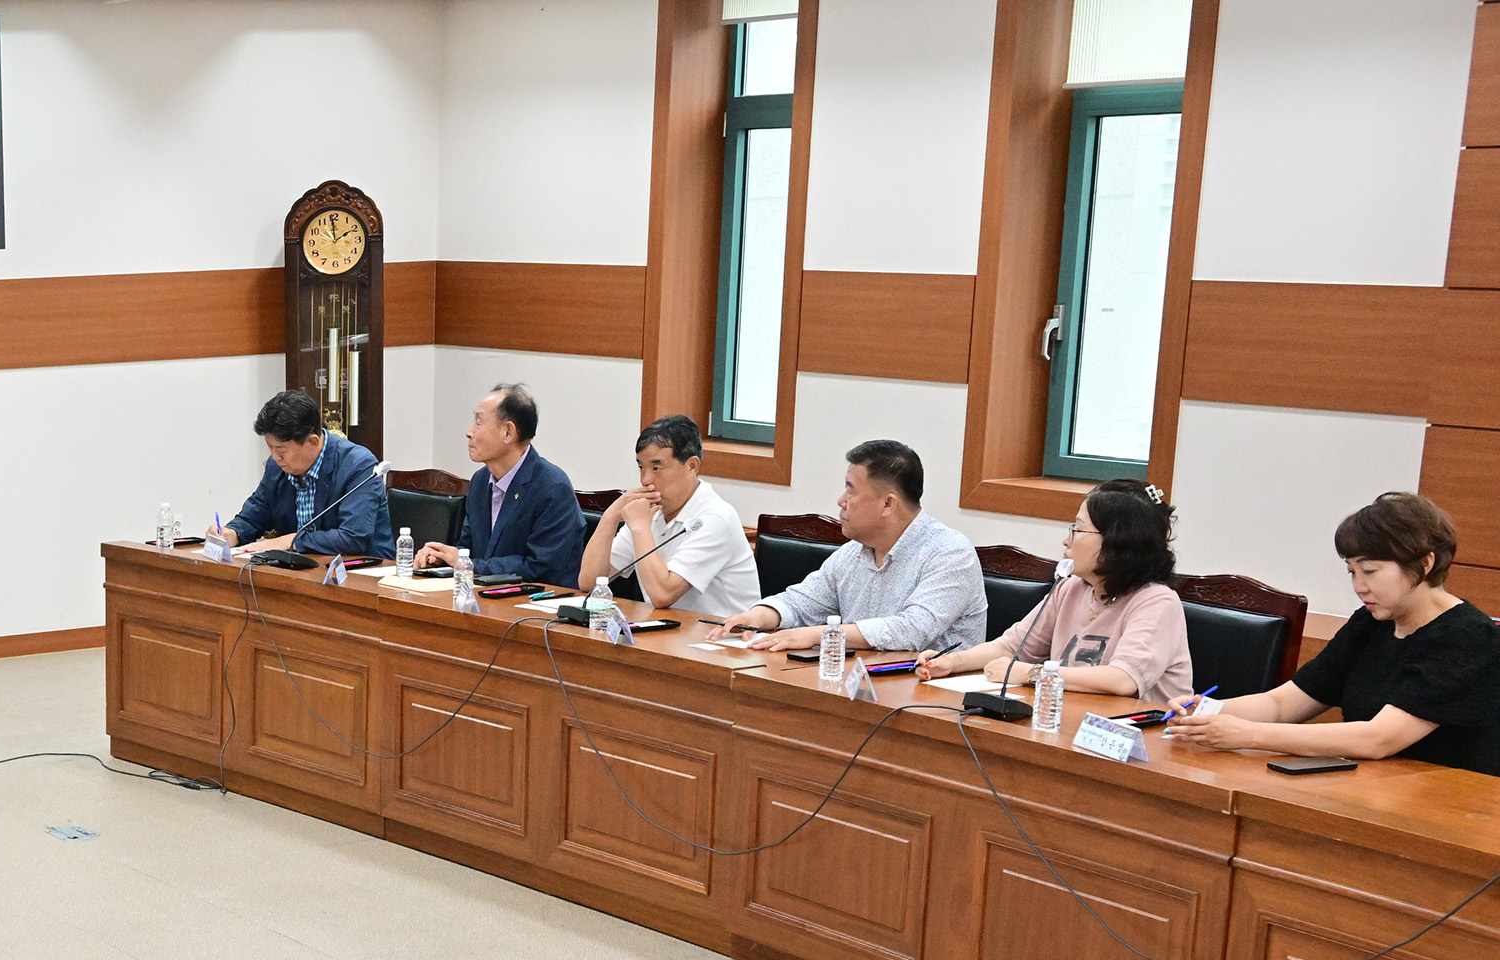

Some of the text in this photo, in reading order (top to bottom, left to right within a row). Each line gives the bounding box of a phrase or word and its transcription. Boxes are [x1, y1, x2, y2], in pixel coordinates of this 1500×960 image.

[311, 228, 319, 236] 10
[308, 239, 315, 247] 9
[355, 236, 362, 244] 3
